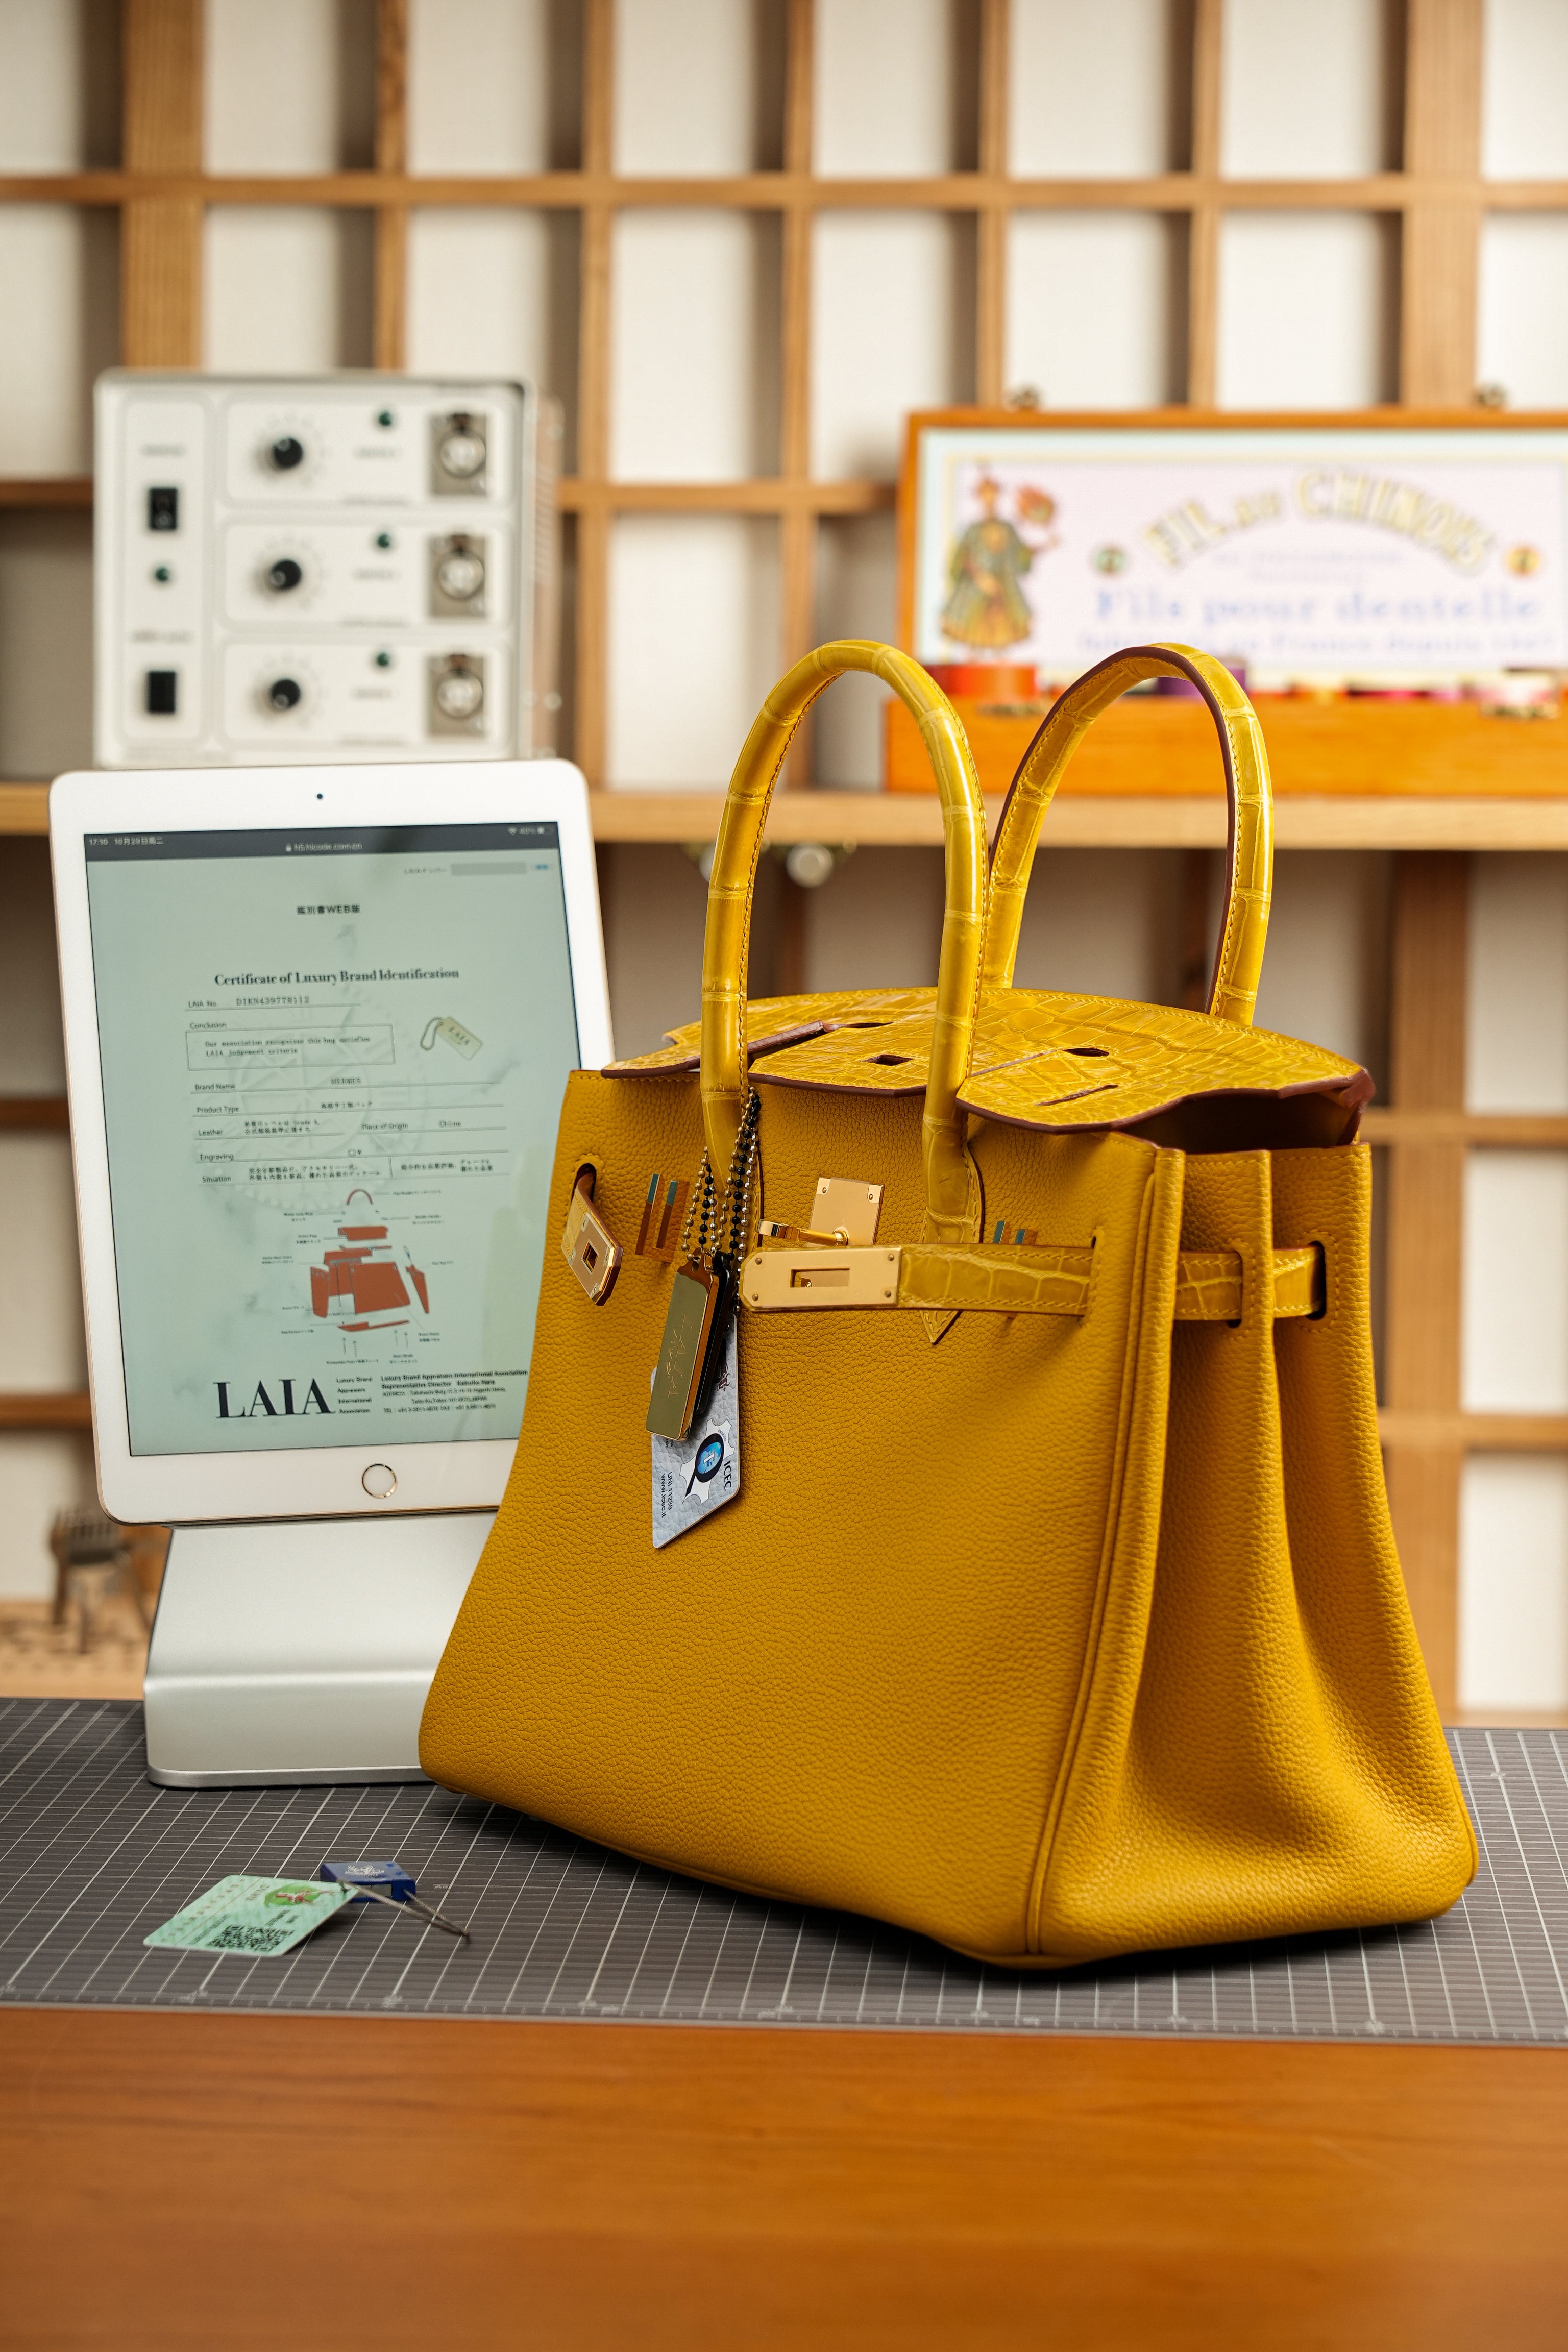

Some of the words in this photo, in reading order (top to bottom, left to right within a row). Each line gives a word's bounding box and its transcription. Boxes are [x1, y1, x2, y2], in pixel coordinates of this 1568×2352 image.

[89, 838, 108, 846] 17:10
[215, 973, 278, 986] Certificate
[280, 971, 292, 984] of
[296, 972, 337, 986] Luxury
[340, 970, 377, 982] Brand
[380, 968, 459, 981] Identification
[194, 1083, 215, 1091] Brand
[224, 1106, 239, 1114] Type
[200, 1153, 234, 1163] Engraving
[212, 1377, 336, 1419] LAIA
